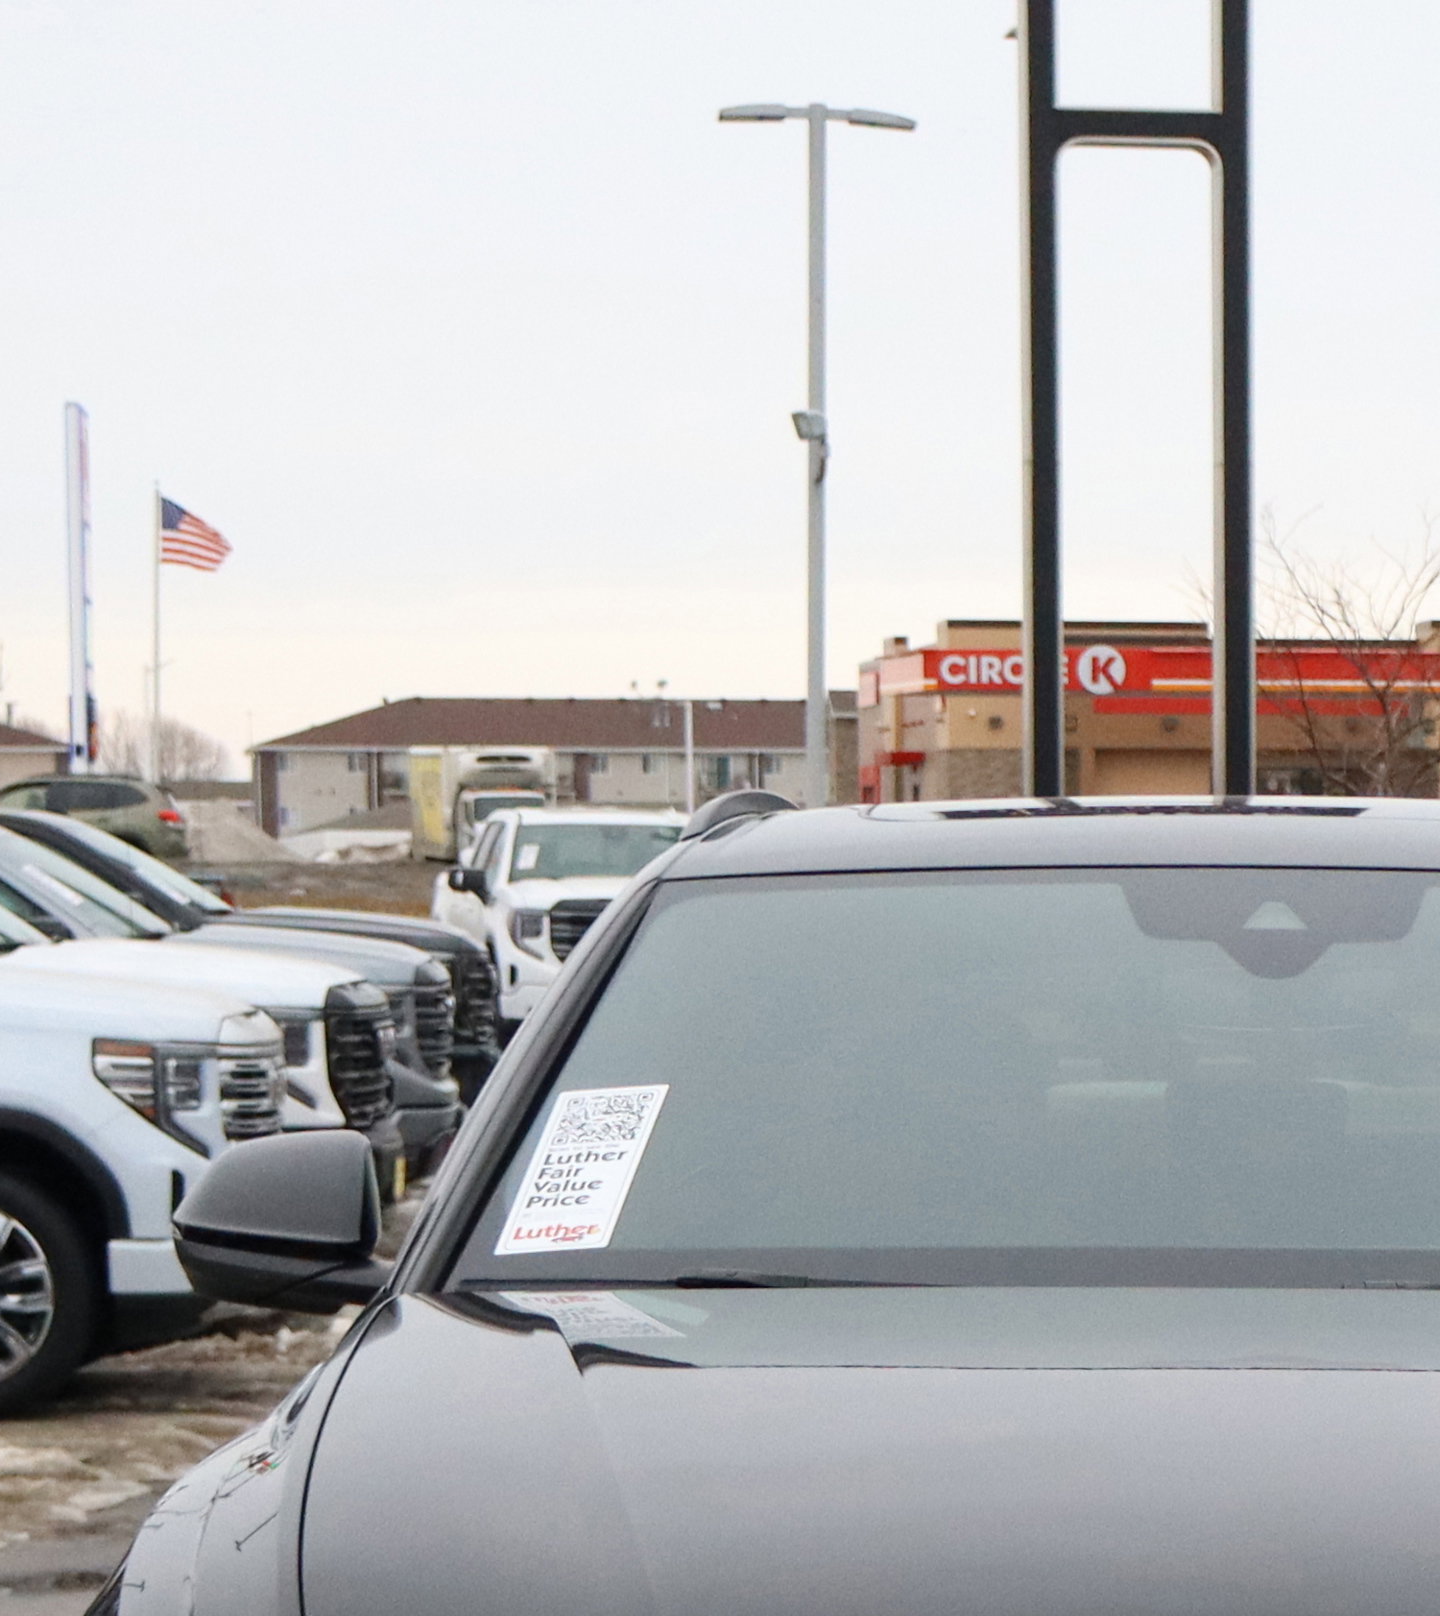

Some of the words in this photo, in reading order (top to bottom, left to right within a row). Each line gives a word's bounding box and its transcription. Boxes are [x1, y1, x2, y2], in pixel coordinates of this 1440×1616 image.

[939, 654, 1069, 685] CIRC
[543, 1150, 629, 1166] Luther
[537, 1166, 585, 1180] Fair
[533, 1179, 604, 1193] Value
[525, 1193, 591, 1209] Price
[512, 1223, 599, 1241] Luther
